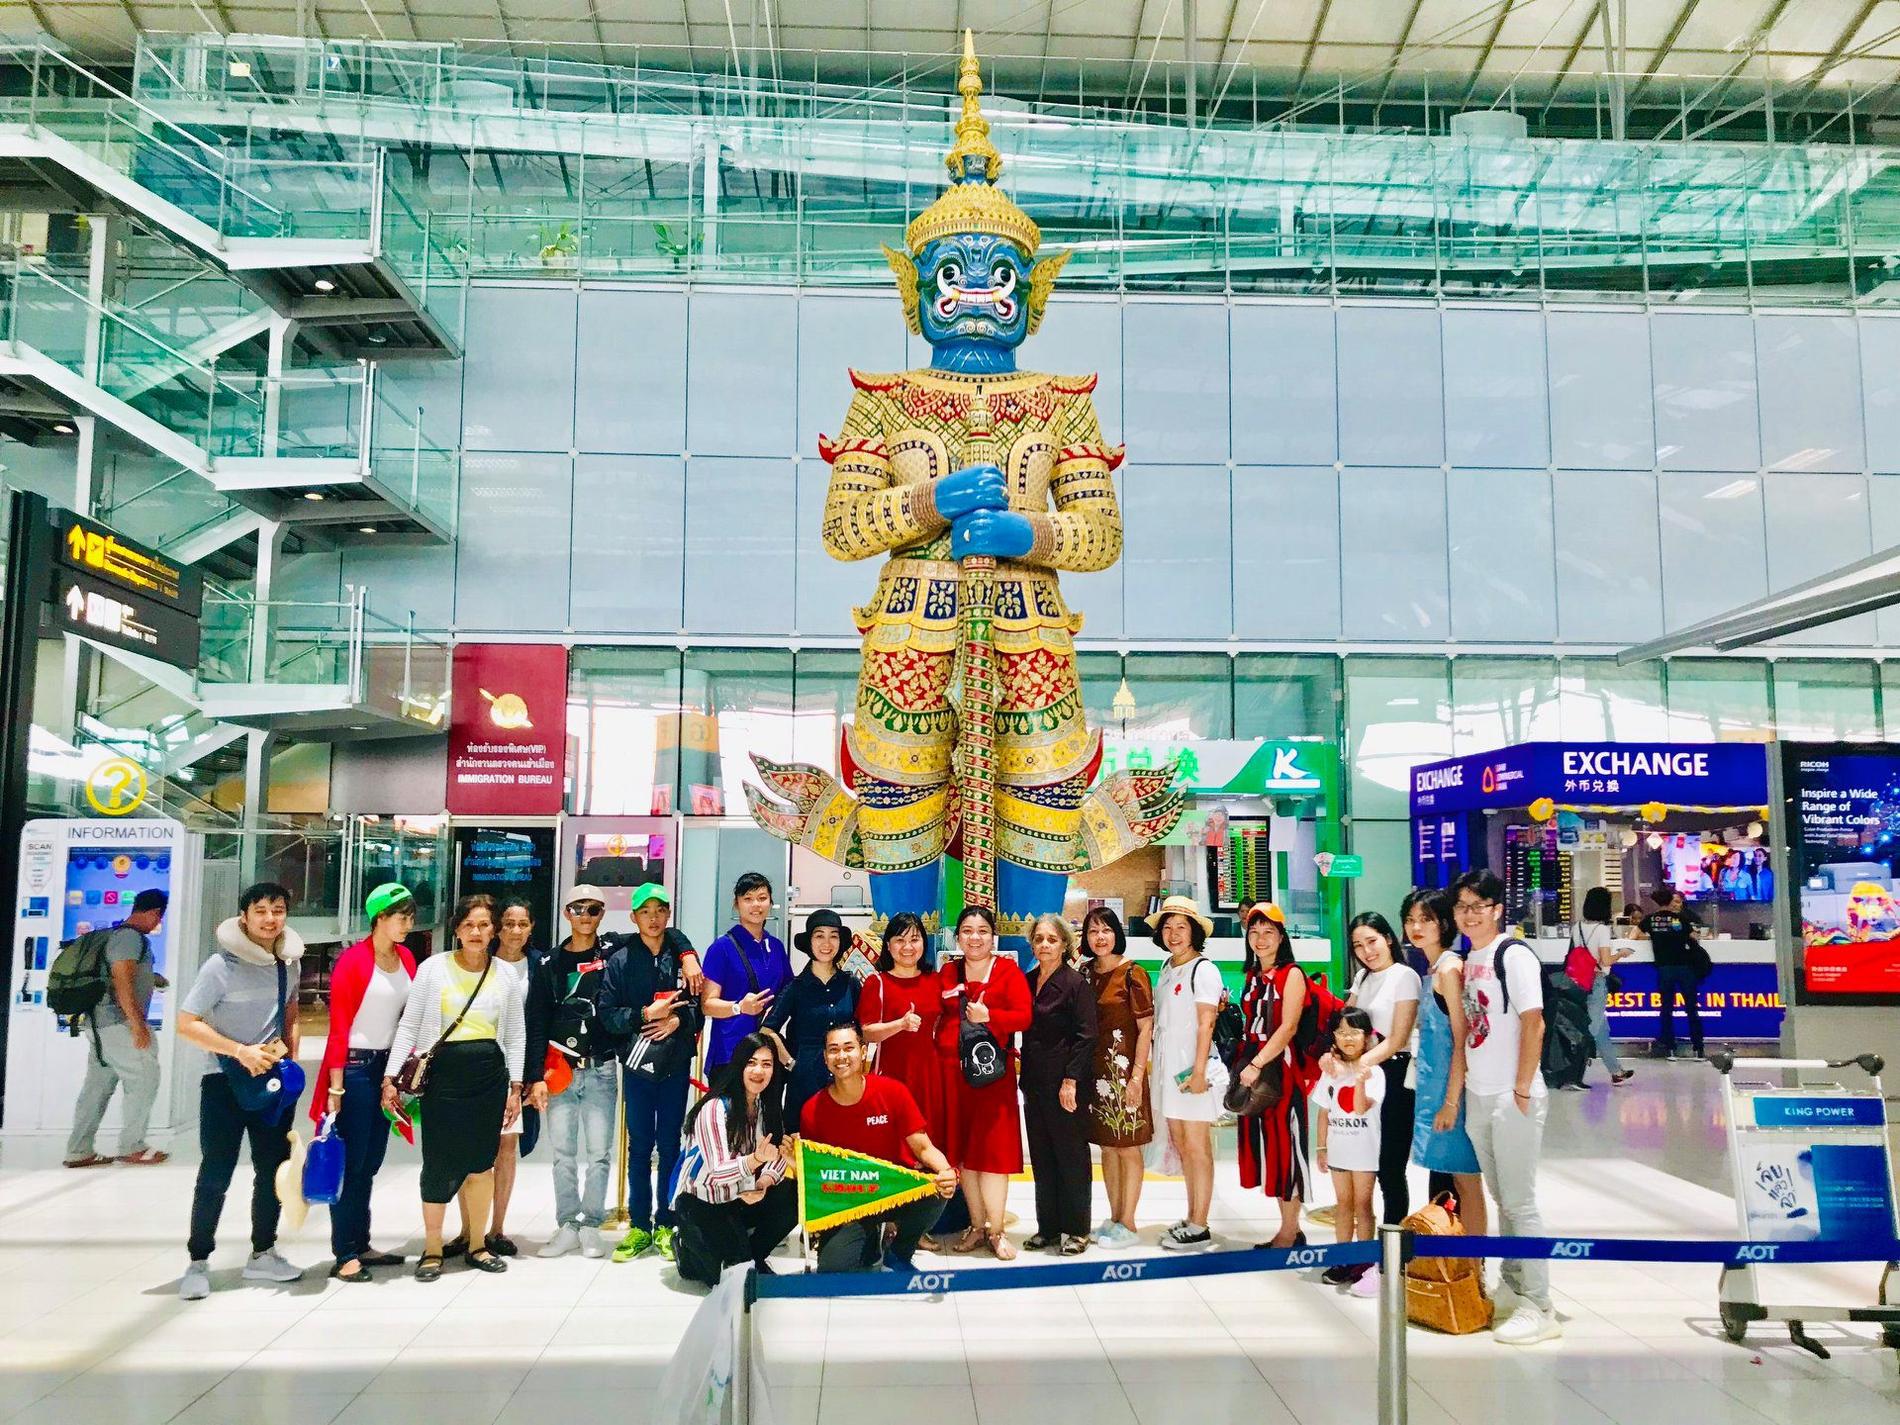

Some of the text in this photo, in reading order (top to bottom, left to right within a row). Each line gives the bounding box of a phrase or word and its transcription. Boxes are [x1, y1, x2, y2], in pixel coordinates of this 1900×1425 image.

[1563, 751, 1709, 776] EXCHANGE
[457, 774, 553, 785] IMMIGRATION BUREAU
[1416, 765, 1463, 792] EXCHANGE
[1564, 779, 1620, 793] 外币兑换
[1801, 788, 1878, 800] Inspire a Wide
[1801, 801, 1852, 814] Range of
[1802, 814, 1881, 825] Vibrant Colors
[67, 826, 174, 840] INFORMATION
[1606, 993, 1645, 1008] BEST
[1707, 993, 1726, 1008] IN
[1784, 1107, 1855, 1117] KING POWER
[866, 1115, 889, 1126] PEACE
[1328, 1117, 1369, 1128] NGKOK
[820, 1169, 880, 1181] VIET NAM
[1286, 1248, 1328, 1266] AOT
[1551, 1242, 1596, 1258] AOT
[1736, 1245, 1780, 1261] AOT
[1102, 1263, 1147, 1281] AOT
[907, 1274, 954, 1291] AOT
